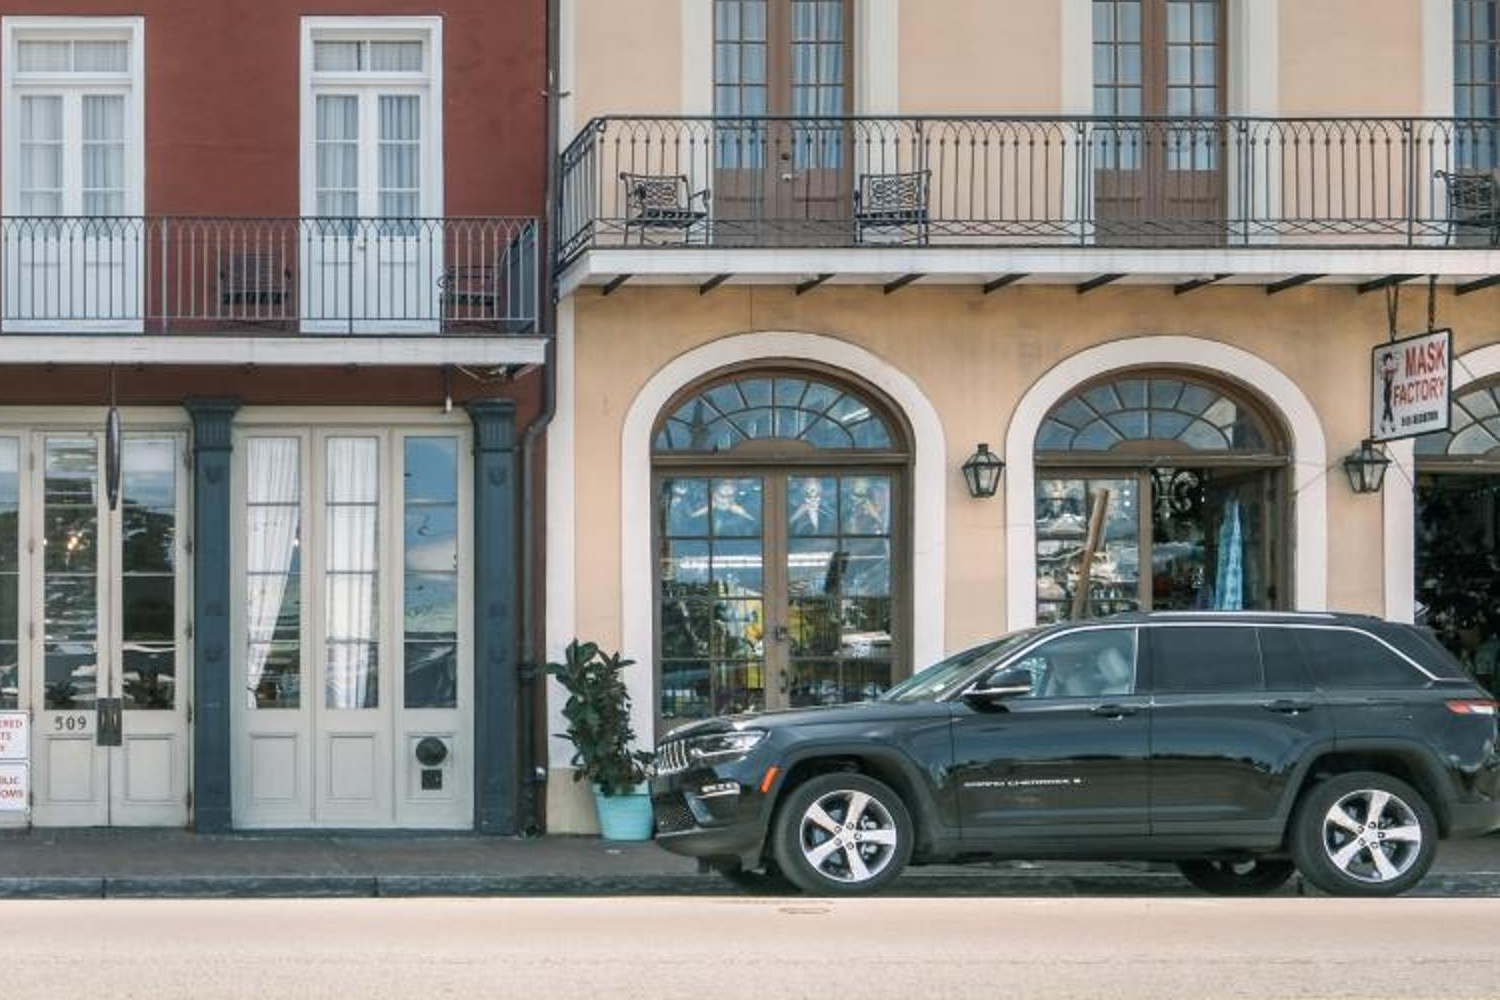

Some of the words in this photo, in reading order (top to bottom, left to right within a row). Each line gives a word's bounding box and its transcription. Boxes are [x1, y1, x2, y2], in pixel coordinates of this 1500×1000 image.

[1405, 340, 1446, 377] MASK
[1393, 377, 1445, 406] FACTORY
[54, 715, 87, 730] 509
